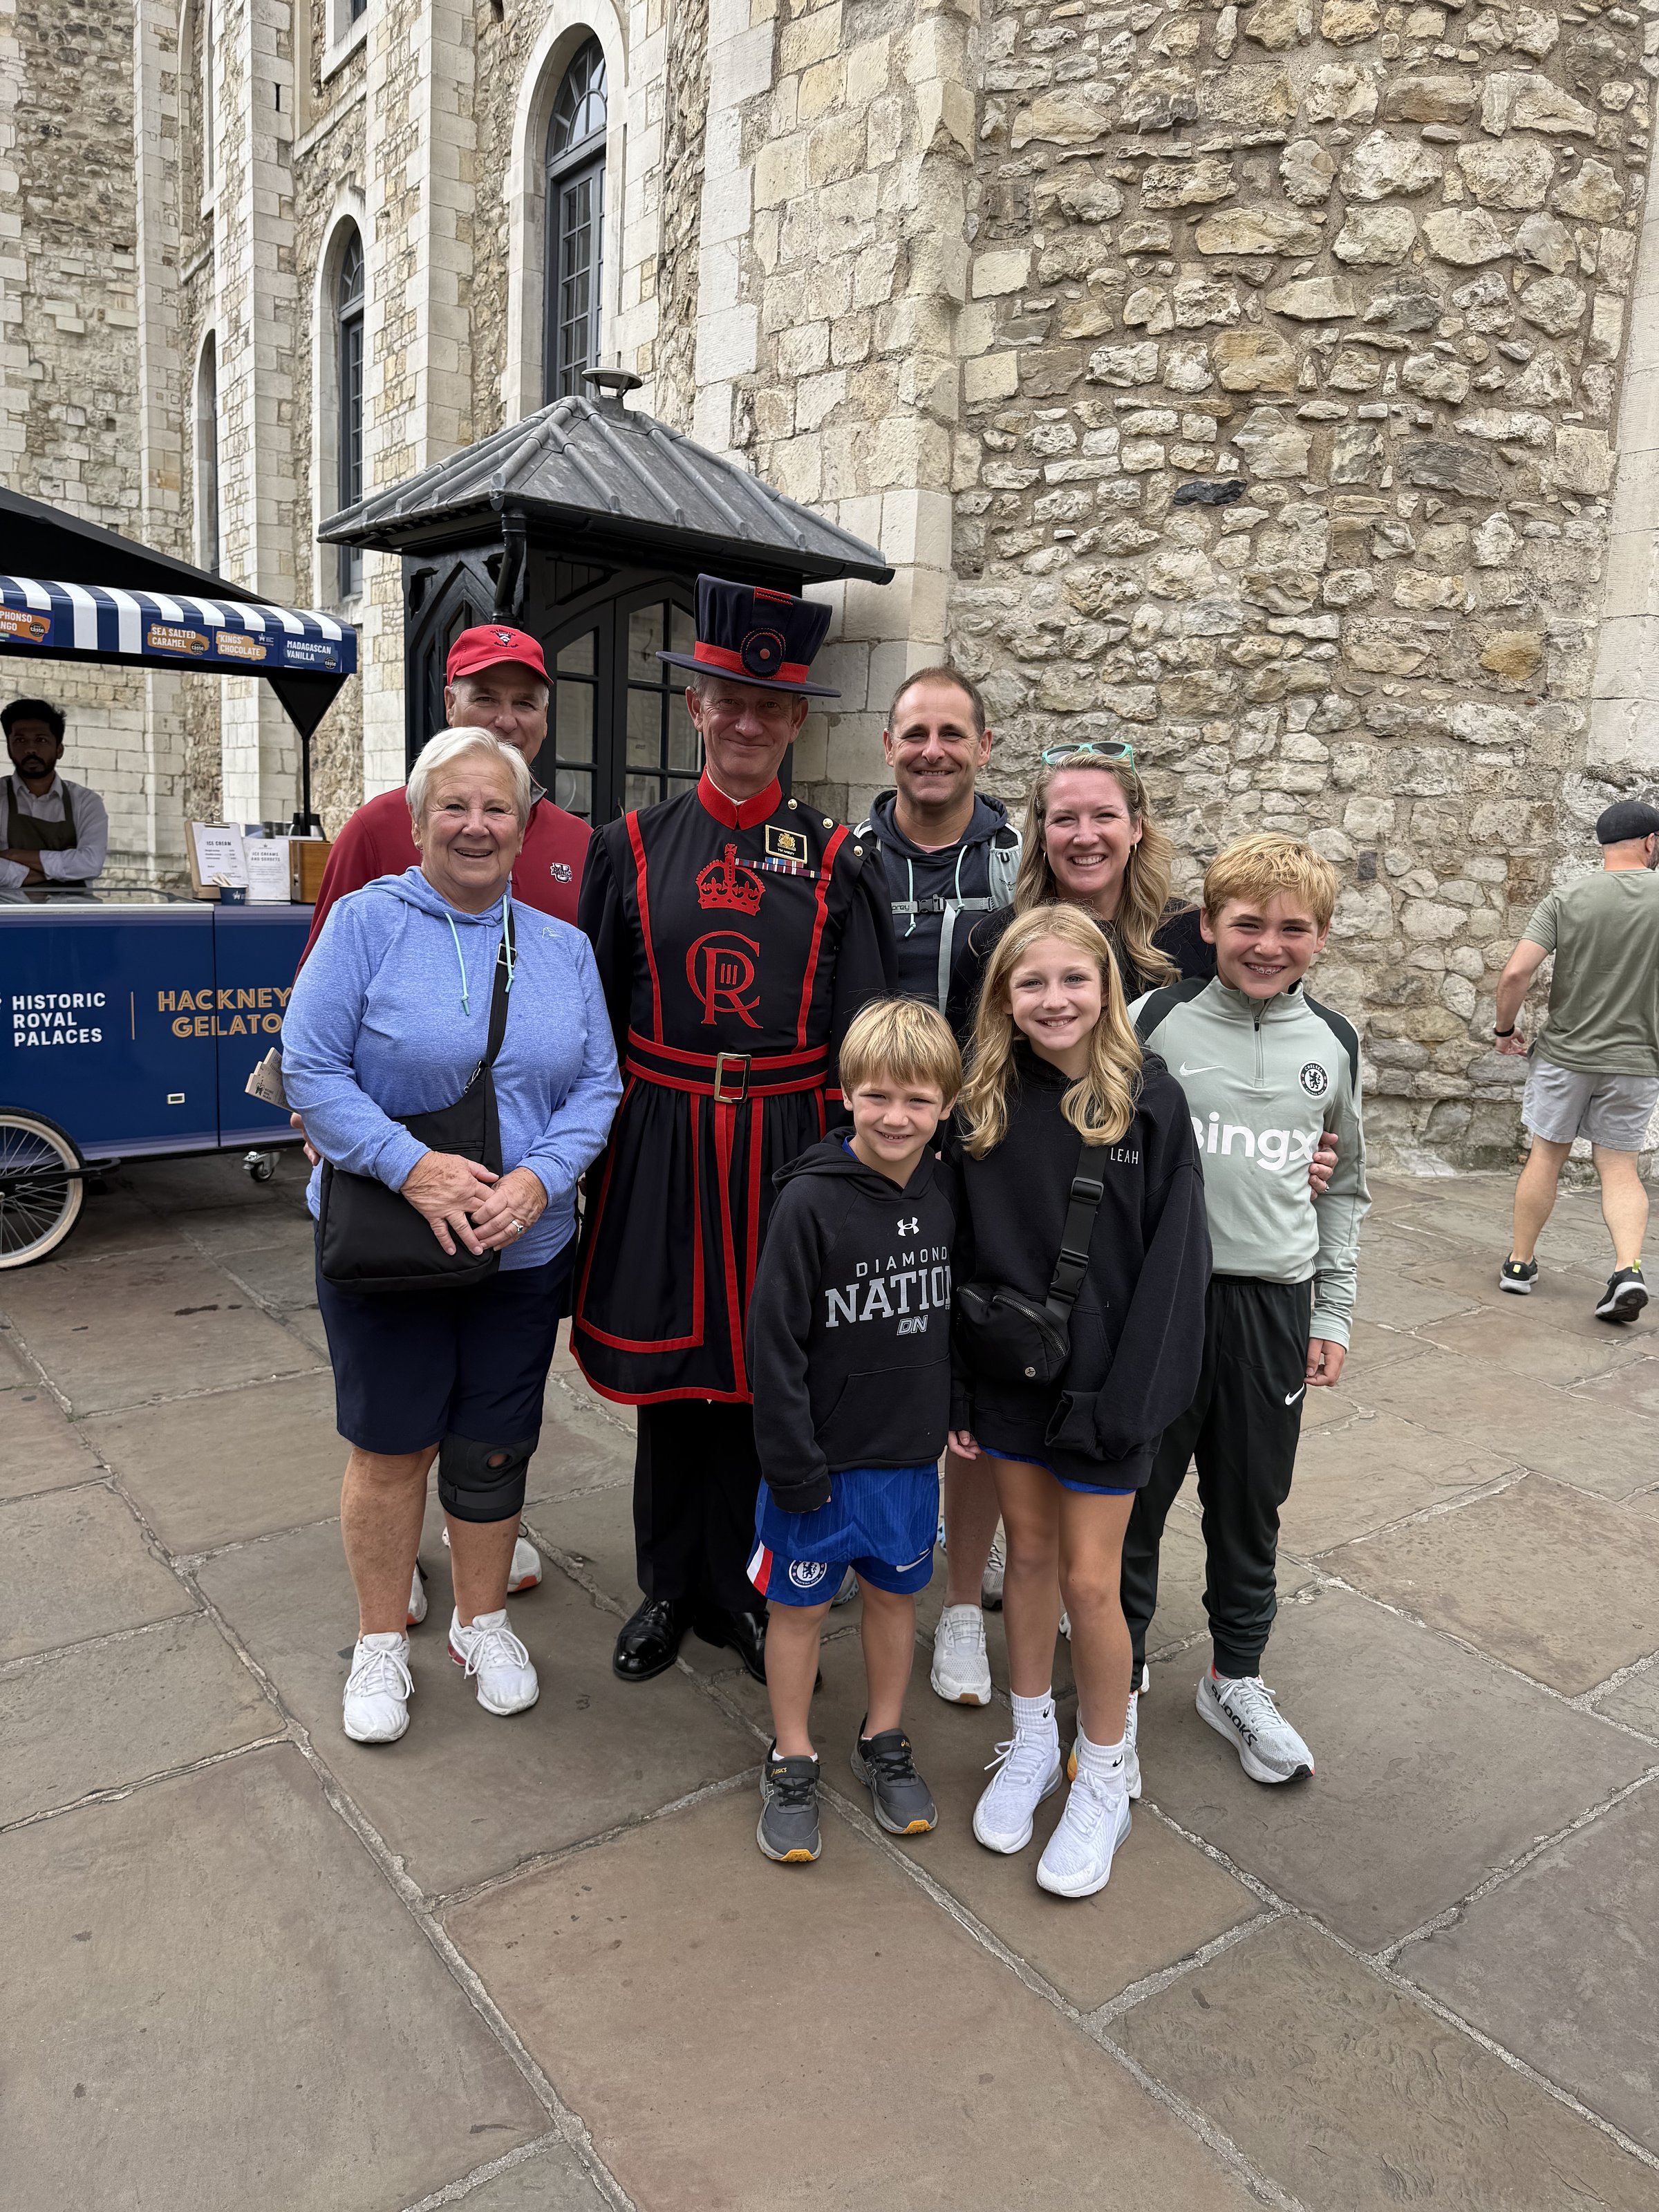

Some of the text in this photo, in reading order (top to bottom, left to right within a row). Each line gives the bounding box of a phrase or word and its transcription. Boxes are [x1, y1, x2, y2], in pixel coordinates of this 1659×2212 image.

[151, 627, 196, 639] SEA SALTED
[151, 637, 187, 648] CARAMEL
[220, 644, 261, 656] CHOCOLATE
[286, 640, 332, 655] MADAGASCAN
[286, 650, 315, 662] VANILLA
[12, 992, 106, 1011] HISTORIC
[158, 987, 292, 1012] HACKNEY
[13, 1011, 77, 1029] ROYAL
[171, 1013, 283, 1038] GELATO
[14, 1027, 103, 1047] PALACES
[1110, 1147, 1138, 1165] LEAH
[856, 1246, 947, 1277] DIAMOND
[896, 1314, 928, 1335] DN
